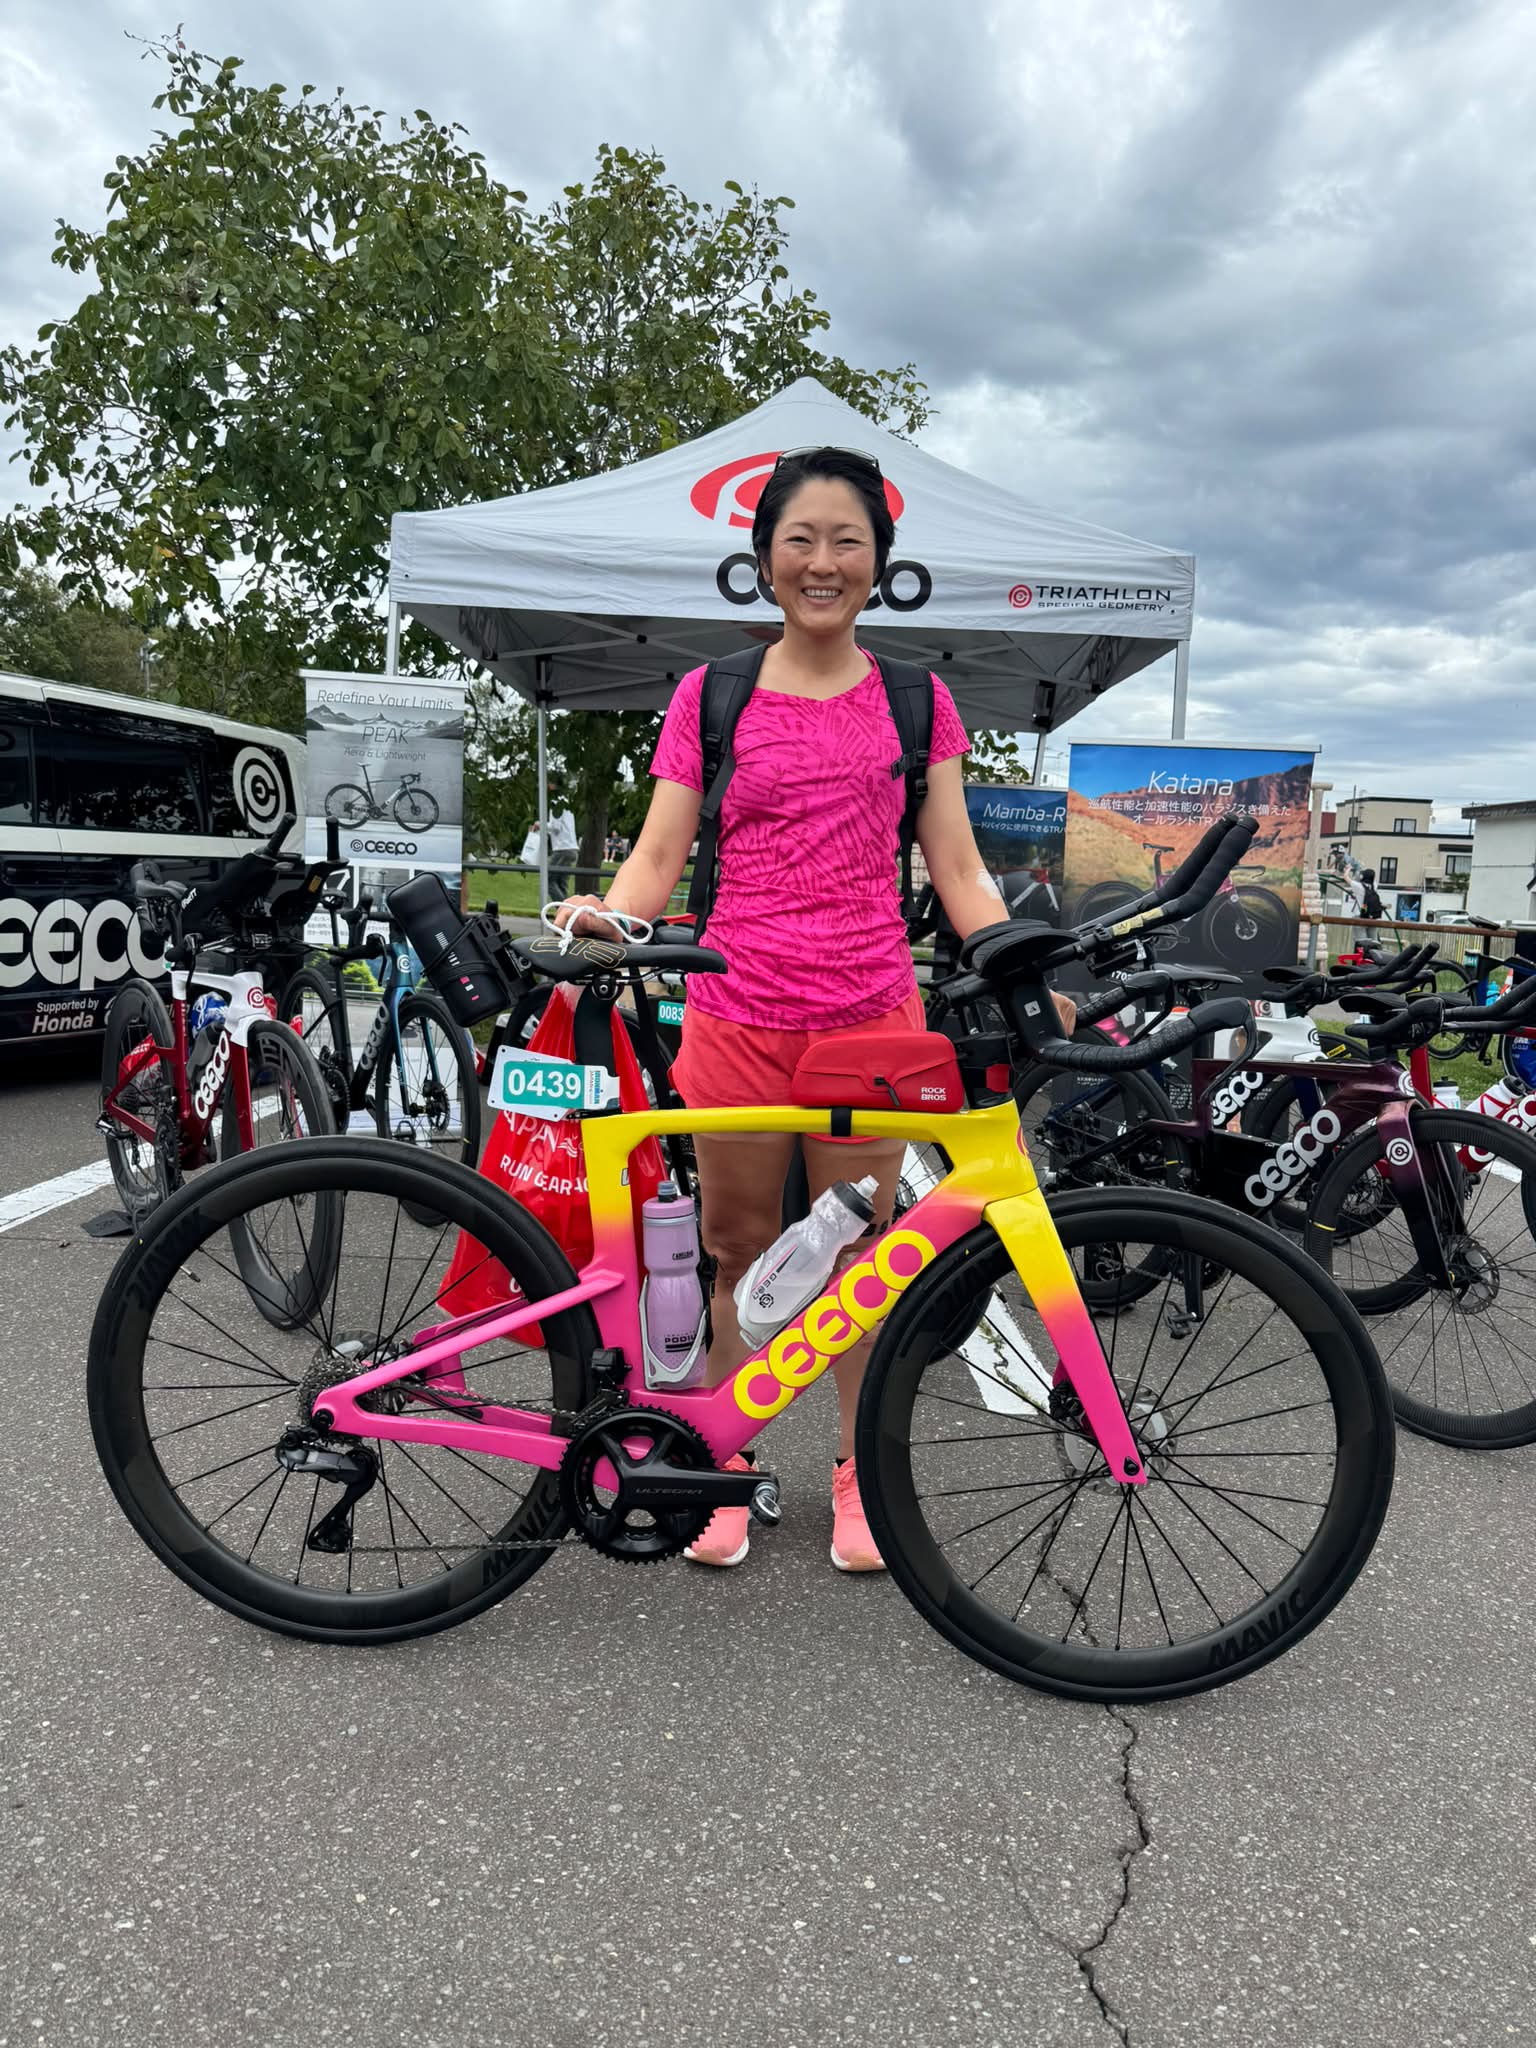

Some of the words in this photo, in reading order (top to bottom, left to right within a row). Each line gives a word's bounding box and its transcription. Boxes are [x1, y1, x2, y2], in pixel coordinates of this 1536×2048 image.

[1036, 585, 1171, 601] TRIATHLON
[1099, 602, 1164, 612] GEOMETRY
[317, 689, 374, 704] Redefine
[379, 693, 409, 709] Your
[362, 726, 408, 745] PEAK
[376, 750, 426, 762] Lightweight
[1147, 771, 1234, 796] Katana
[983, 803, 1066, 821] Mamba-R
[37, 999, 86, 1013] Supported
[88, 999, 99, 1010] by
[659, 1005, 684, 1021] 0083
[32, 1012, 94, 1033] Honda
[508, 1068, 581, 1100] 0439
[503, 1110, 560, 1152] APAN
[500, 1154, 533, 1182] RUN
[534, 1171, 573, 1195] GEAR
[665, 1334, 697, 1343] PODIU
[1210, 1587, 1304, 1661] MAVIC
